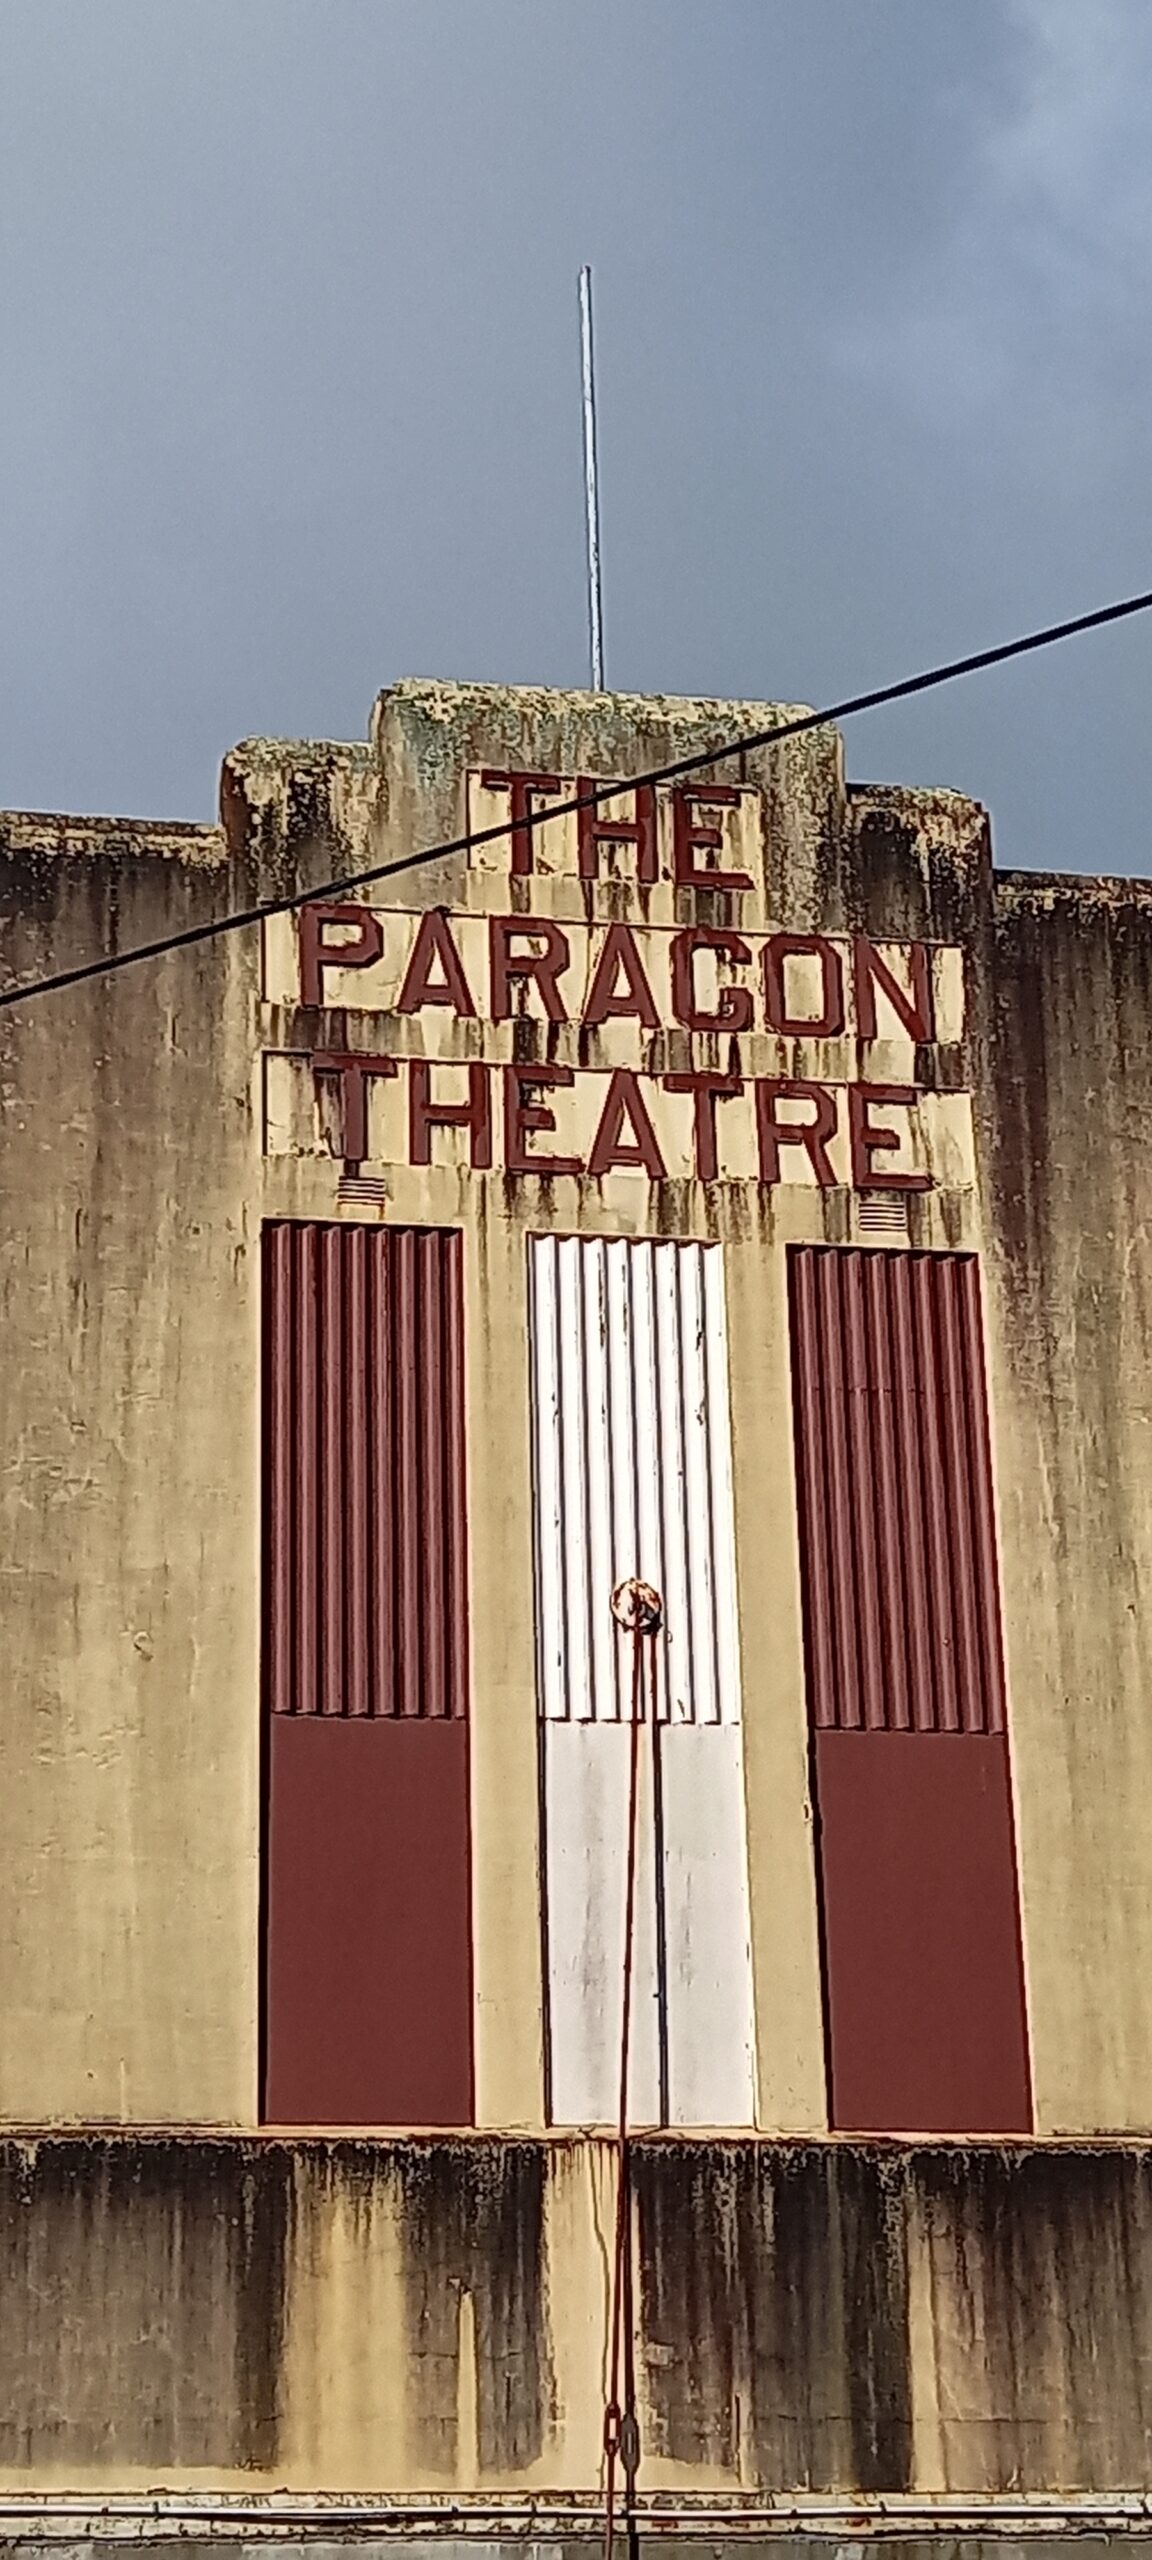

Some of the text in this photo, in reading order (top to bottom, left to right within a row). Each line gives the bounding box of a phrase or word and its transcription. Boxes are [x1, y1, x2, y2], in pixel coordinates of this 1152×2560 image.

[481, 769, 755, 890] THE
[300, 903, 935, 1043] PARAGON
[312, 1052, 934, 1191] THEATRE
